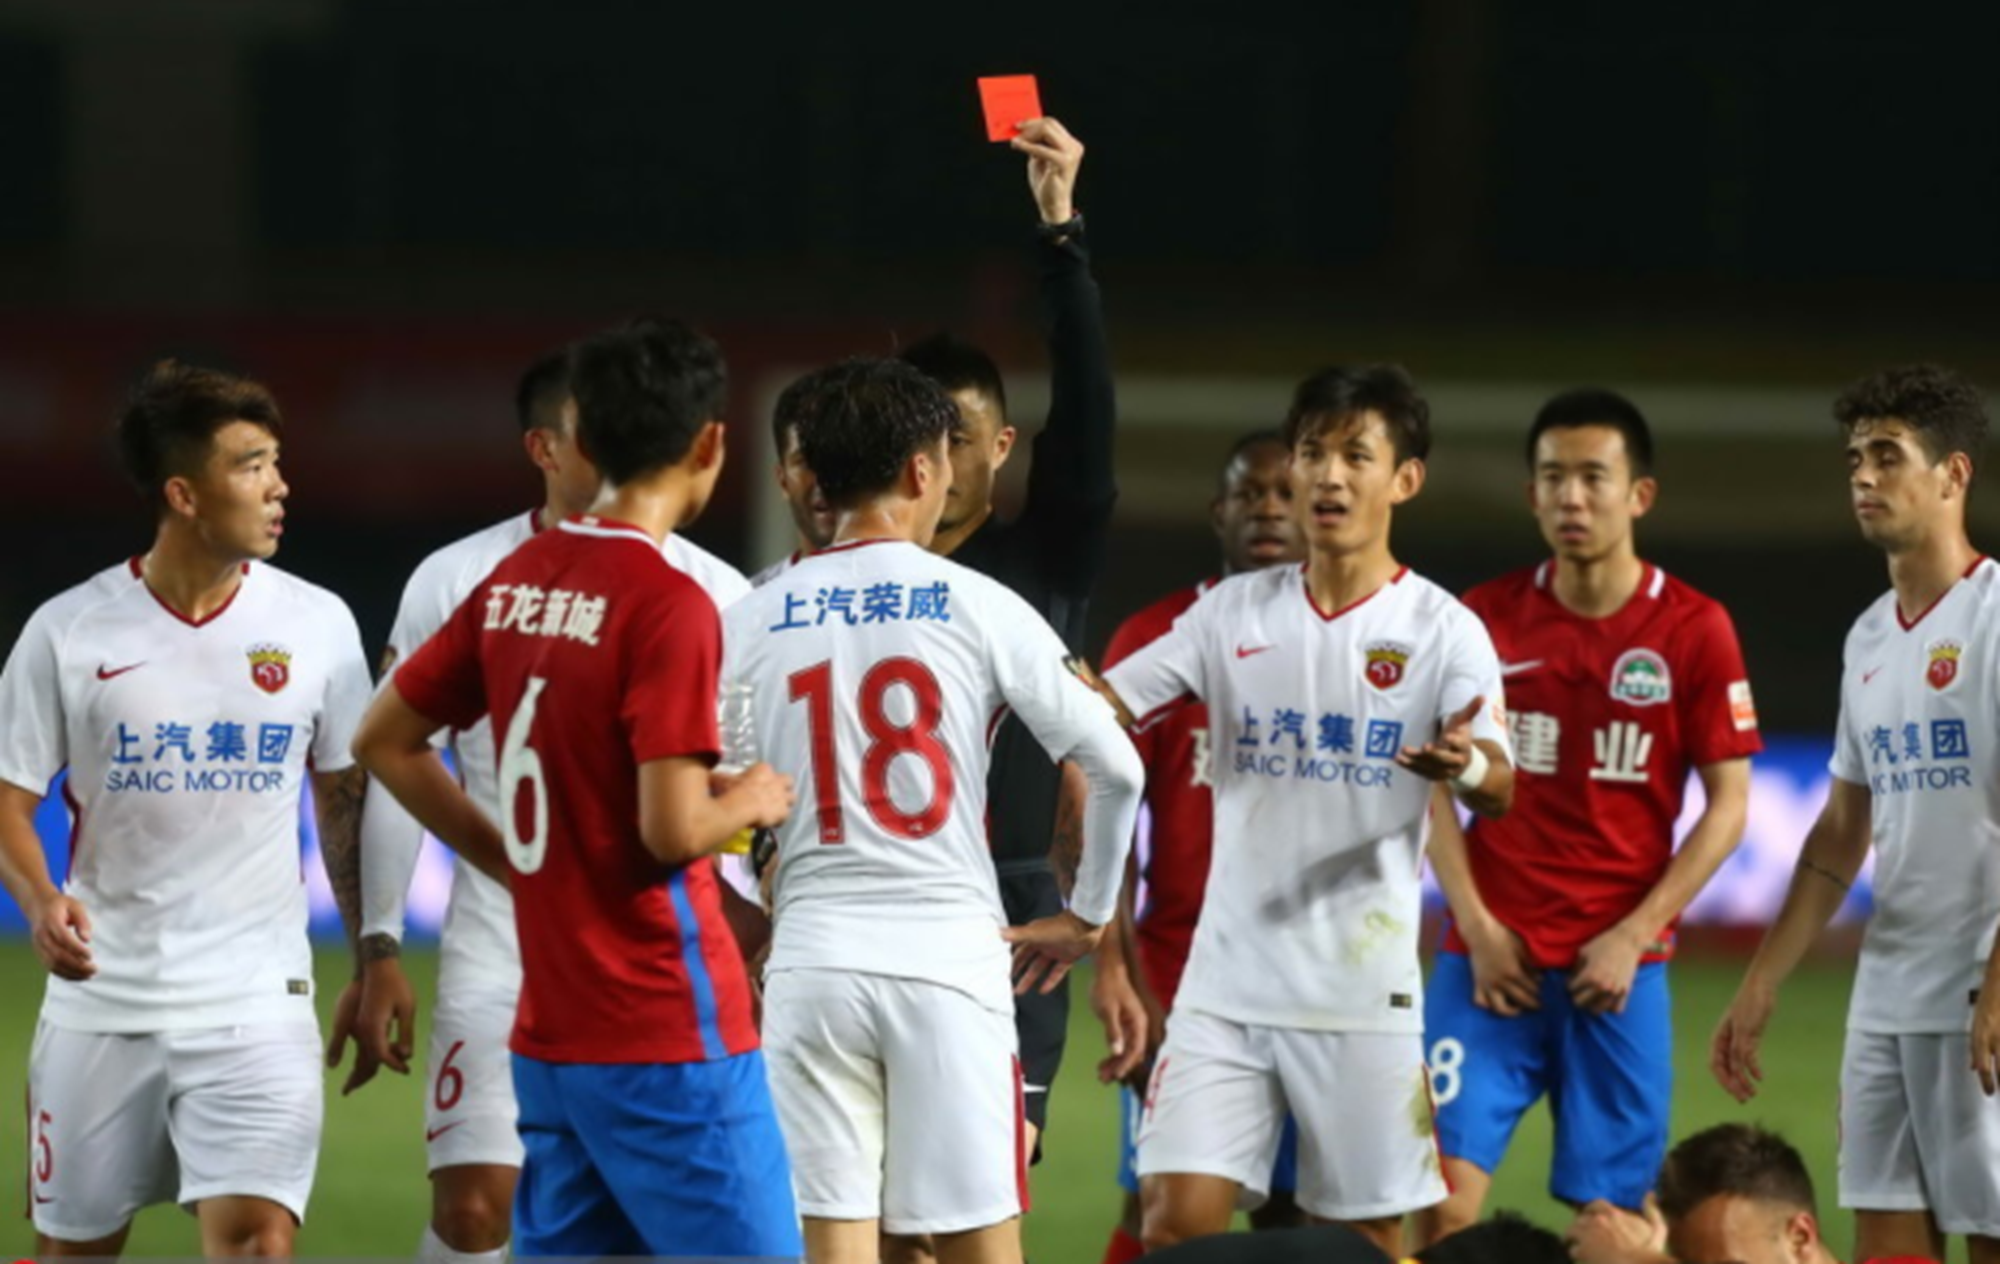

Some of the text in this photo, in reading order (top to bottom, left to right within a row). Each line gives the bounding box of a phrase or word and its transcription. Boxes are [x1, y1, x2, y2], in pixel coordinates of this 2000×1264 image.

[769, 581, 952, 632] 上汽荣威
[112, 721, 294, 764] 上汽集团
[787, 656, 956, 845] 18
[1236, 706, 1403, 759] 上汽集团
[1505, 709, 1653, 783] 建业
[106, 769, 283, 793] SAIC MOTOR
[500, 677, 548, 875] 6
[1234, 752, 1286, 778] SAIC
[1294, 756, 1393, 788] MOTOR
[1891, 764, 1972, 794] MTOR
[434, 1040, 465, 1112] 6
[1429, 1036, 1466, 1106] 8
[36, 1108, 53, 1183] 5
